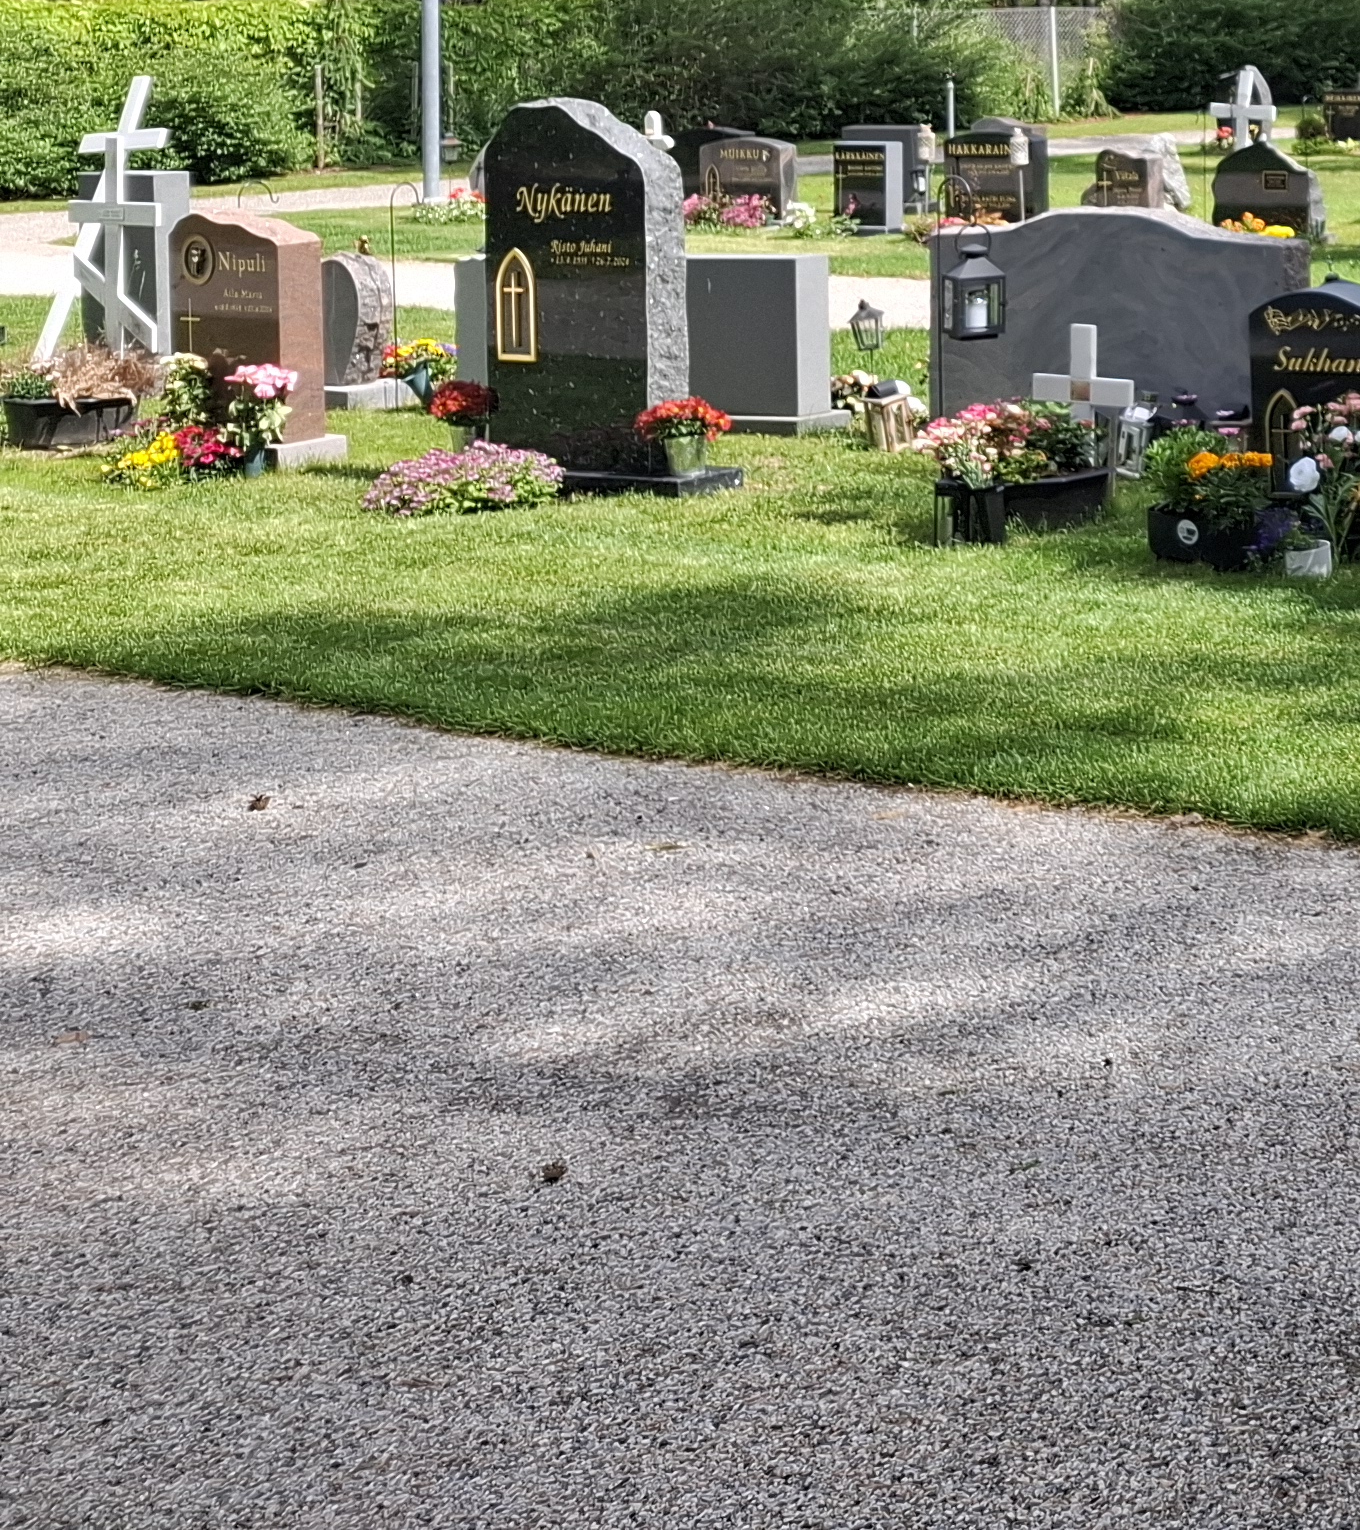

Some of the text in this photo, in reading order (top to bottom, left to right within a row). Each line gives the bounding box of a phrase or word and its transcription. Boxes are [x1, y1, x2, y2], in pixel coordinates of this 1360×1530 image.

[948, 143, 1013, 155] HAKKARAIN
[516, 182, 612, 223] Nykänen
[550, 239, 612, 255] Risto Juhani
[218, 251, 266, 279] Nipuli
